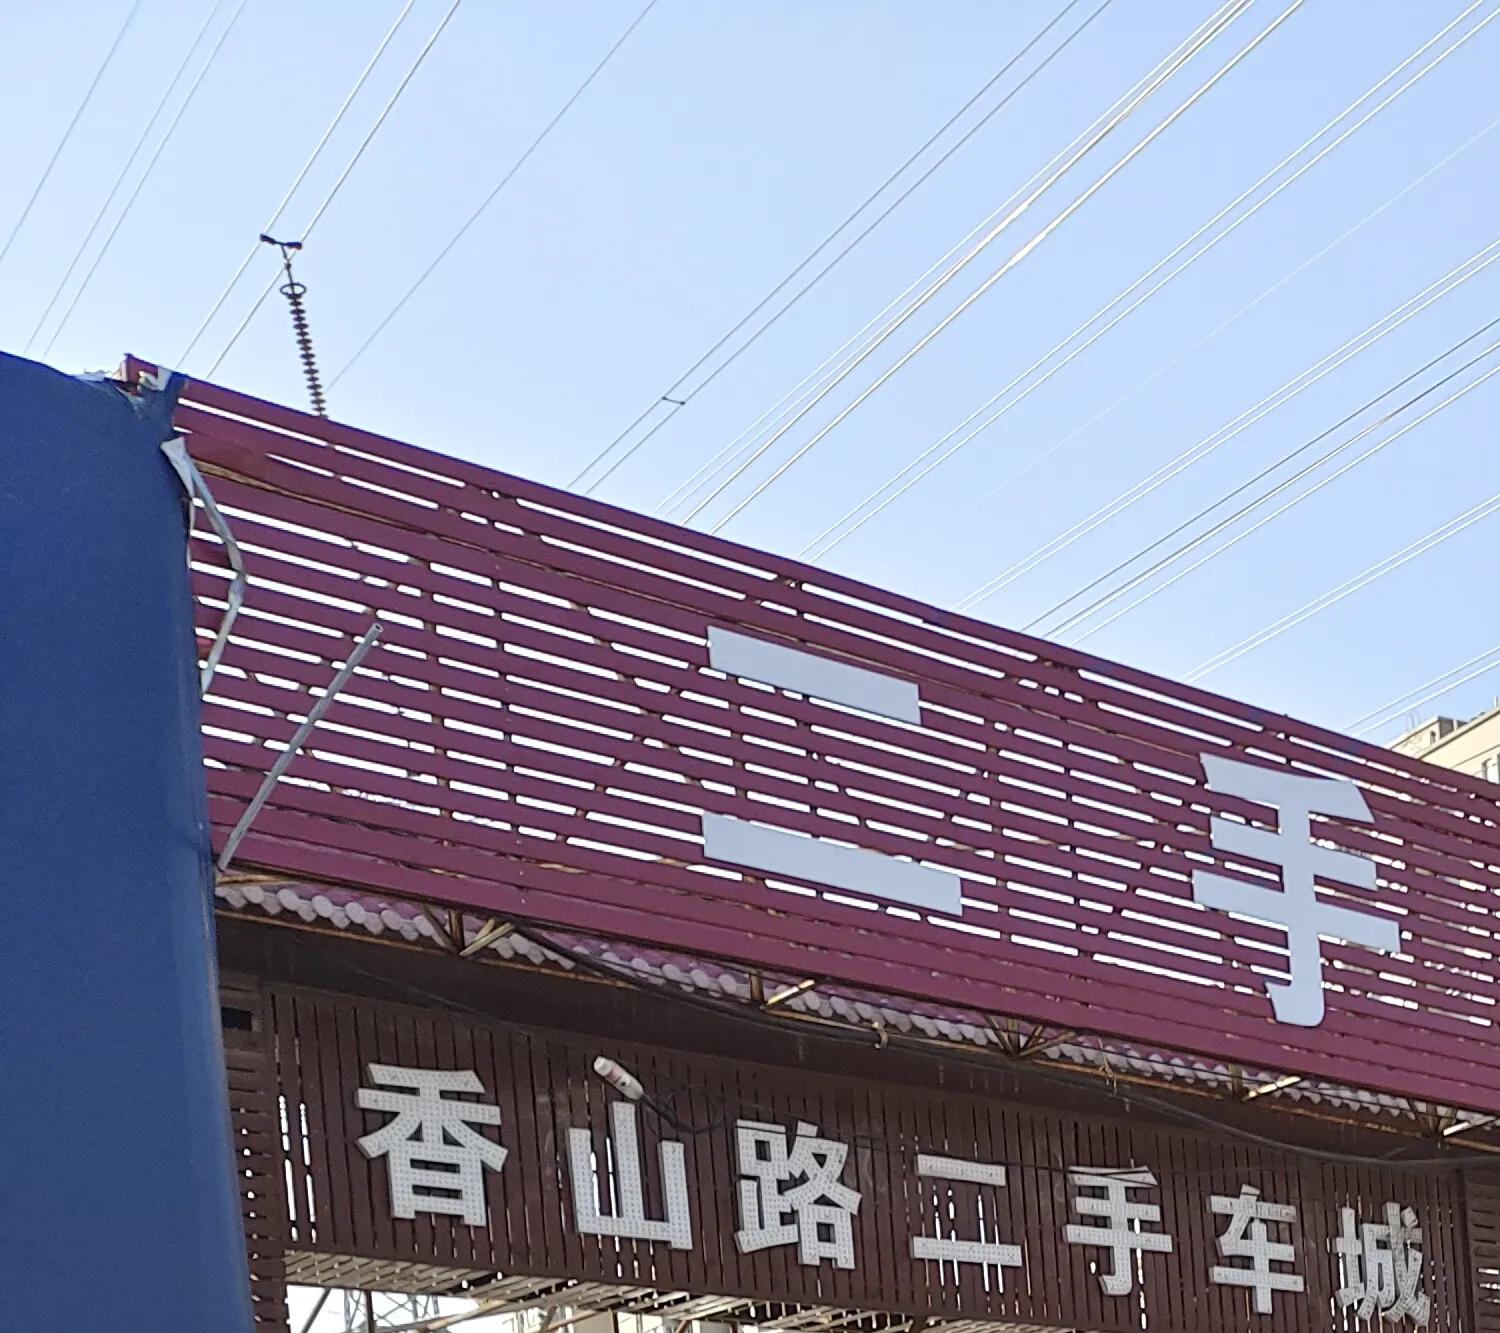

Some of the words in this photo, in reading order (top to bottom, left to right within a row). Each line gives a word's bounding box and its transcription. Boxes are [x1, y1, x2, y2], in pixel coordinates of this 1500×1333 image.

[354, 1063, 1432, 1327] 香山路二手车城
